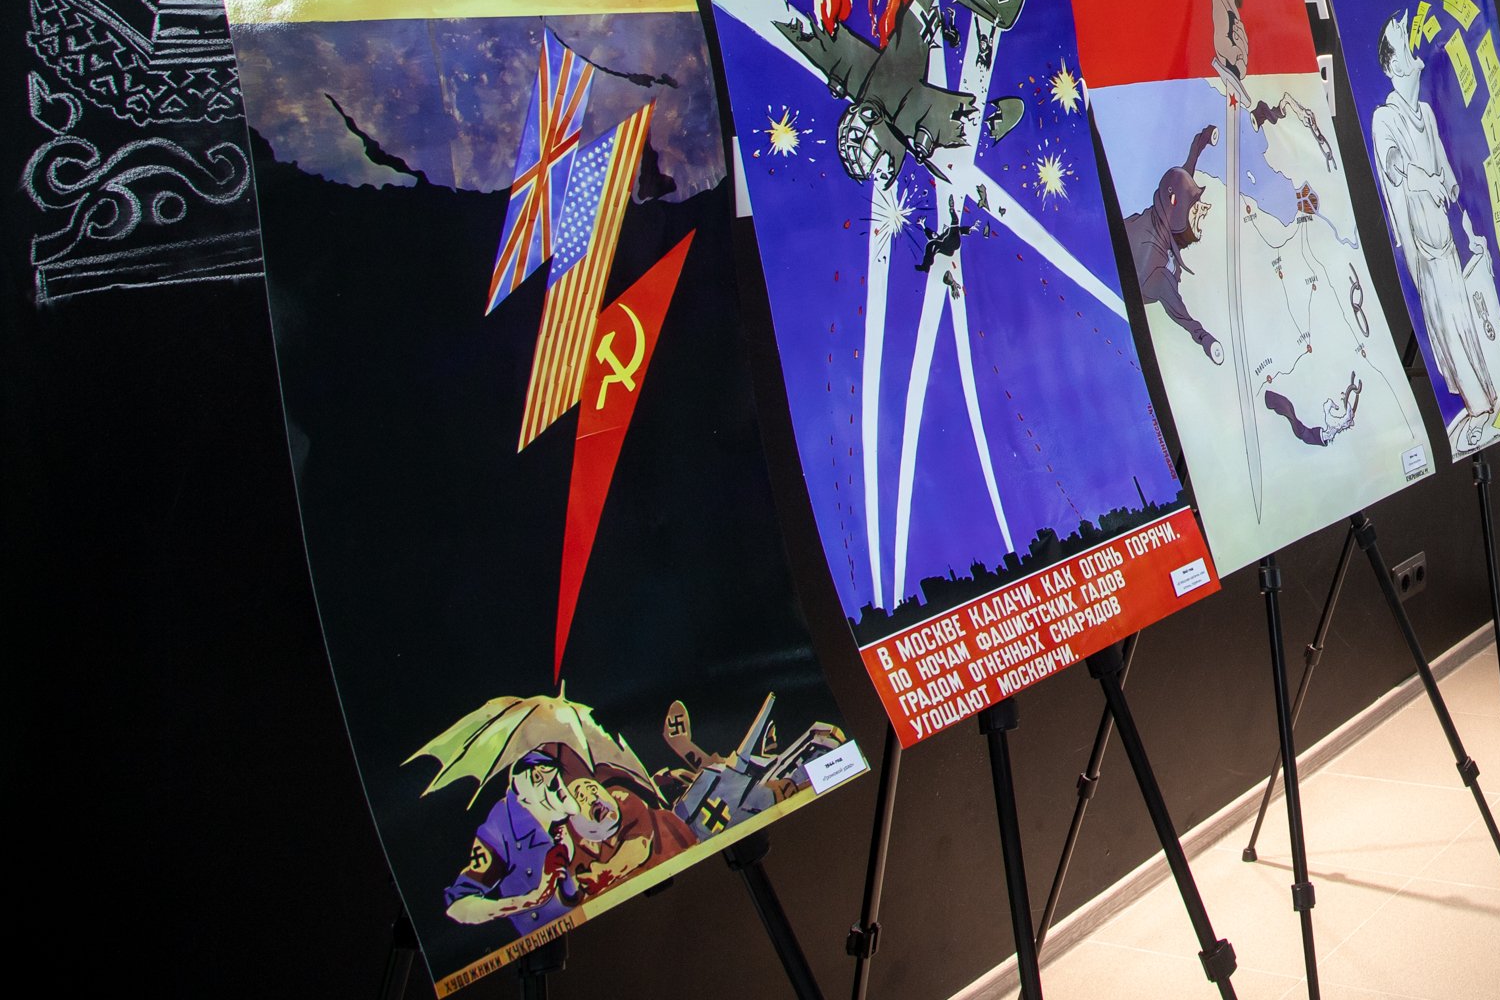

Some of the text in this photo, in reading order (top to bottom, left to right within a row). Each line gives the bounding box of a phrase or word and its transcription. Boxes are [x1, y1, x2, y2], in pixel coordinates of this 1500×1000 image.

[876, 521, 1181, 671] В МОСКВЕ КАЛАЧИ, КАК ОГОНЬ ГОРЯЧИ.
[888, 569, 1127, 694] ПО НОЧАМ ФАШИСТСКИХ ГАДОВ
[899, 596, 1122, 717] ГРАДОМ ОГНЕННЫХ СНАРЯДОВ
[909, 644, 1080, 740] УГОЩАЮТ МОСКВИЧИ.
[444, 916, 576, 994] ХУДОЖНИКИ КУКРЫНИКСЫ
